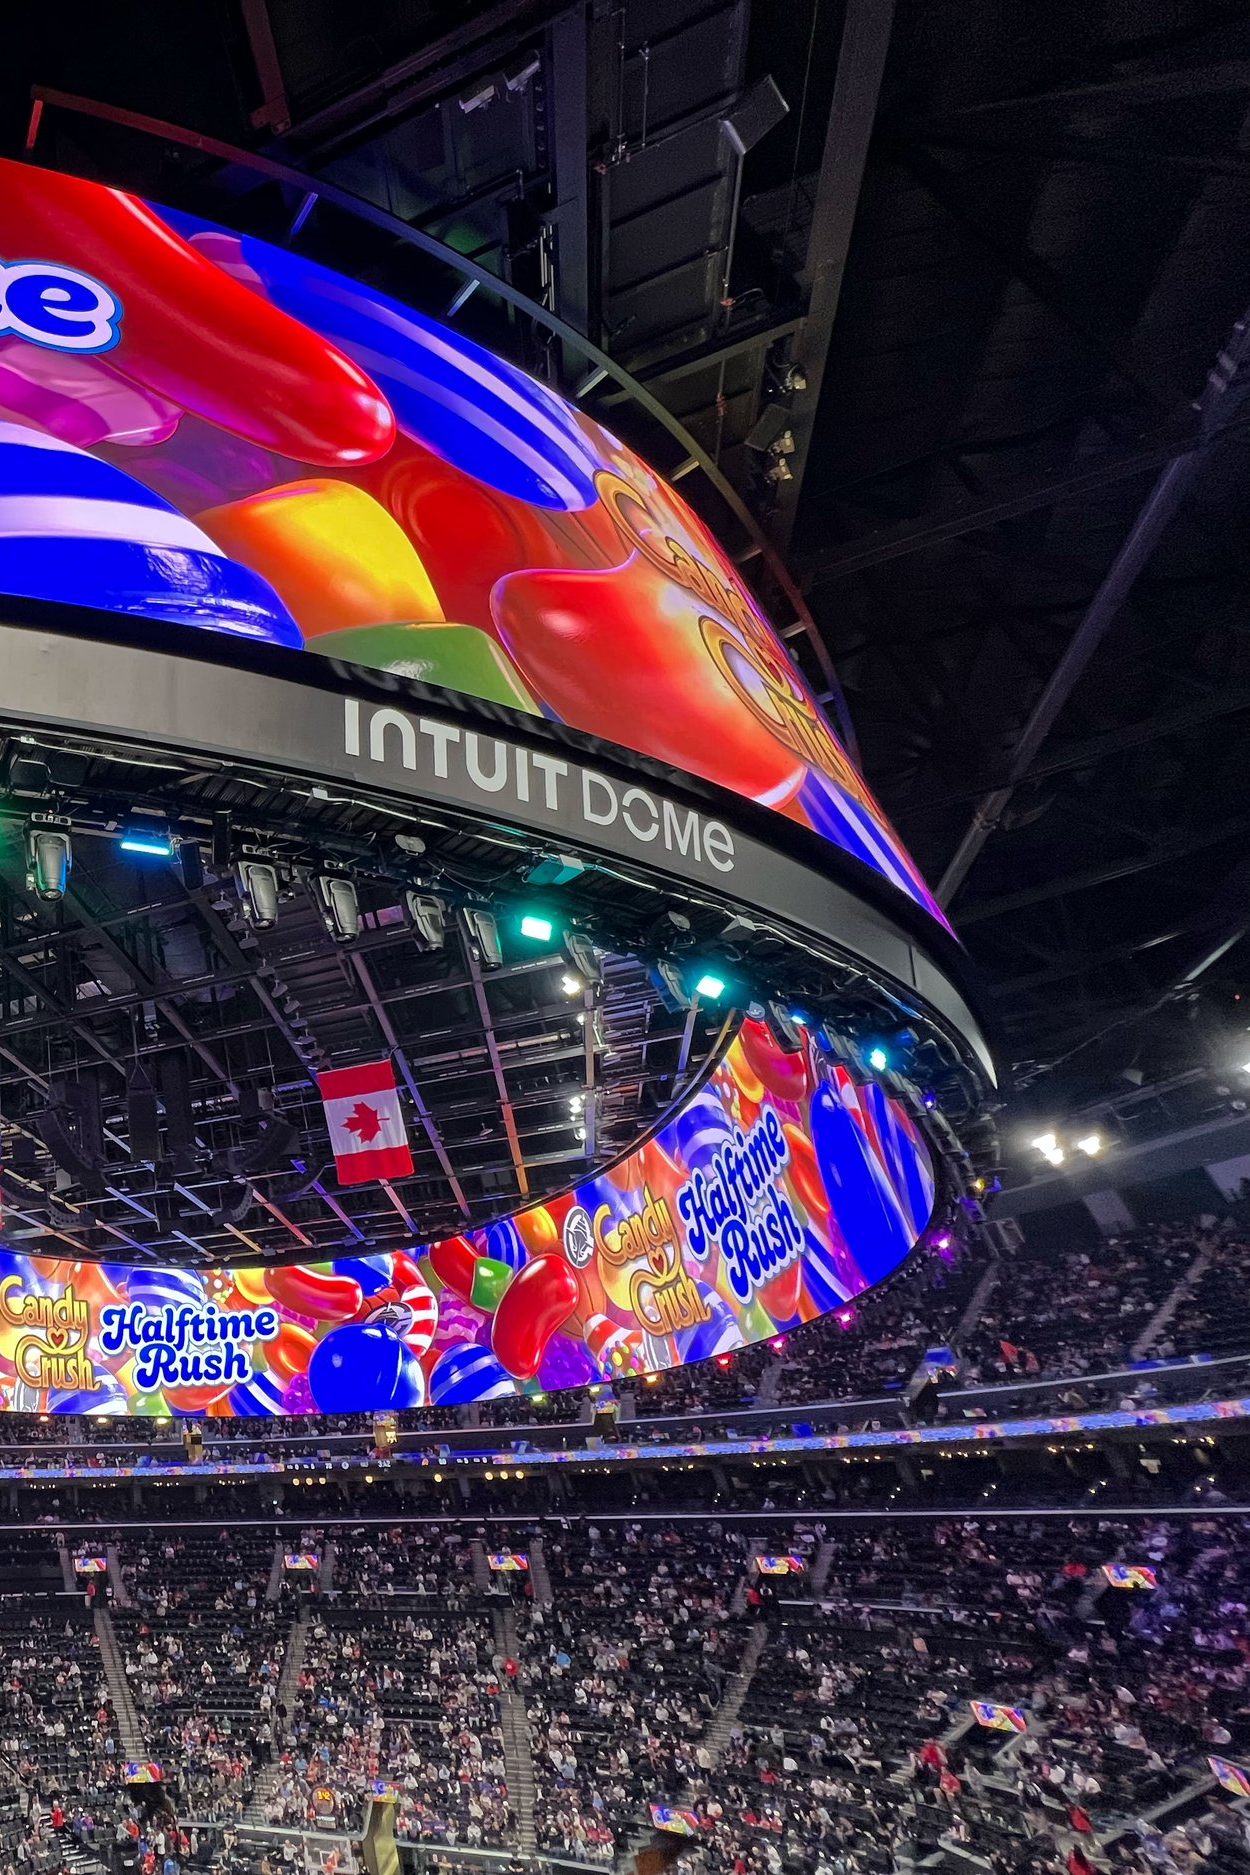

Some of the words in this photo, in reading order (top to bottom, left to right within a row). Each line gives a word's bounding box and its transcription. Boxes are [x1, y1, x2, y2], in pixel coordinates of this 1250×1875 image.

[344, 698, 568, 811] INTUIT
[582, 768, 735, 873] DOME
[678, 1108, 786, 1255] Halftime
[593, 1184, 681, 1275] Candy
[719, 1183, 802, 1300] Rush
[101, 1303, 276, 1351] Halftime
[629, 1264, 712, 1337] Crush
[14, 1333, 101, 1391] Crush
[134, 1341, 250, 1389] Rush
